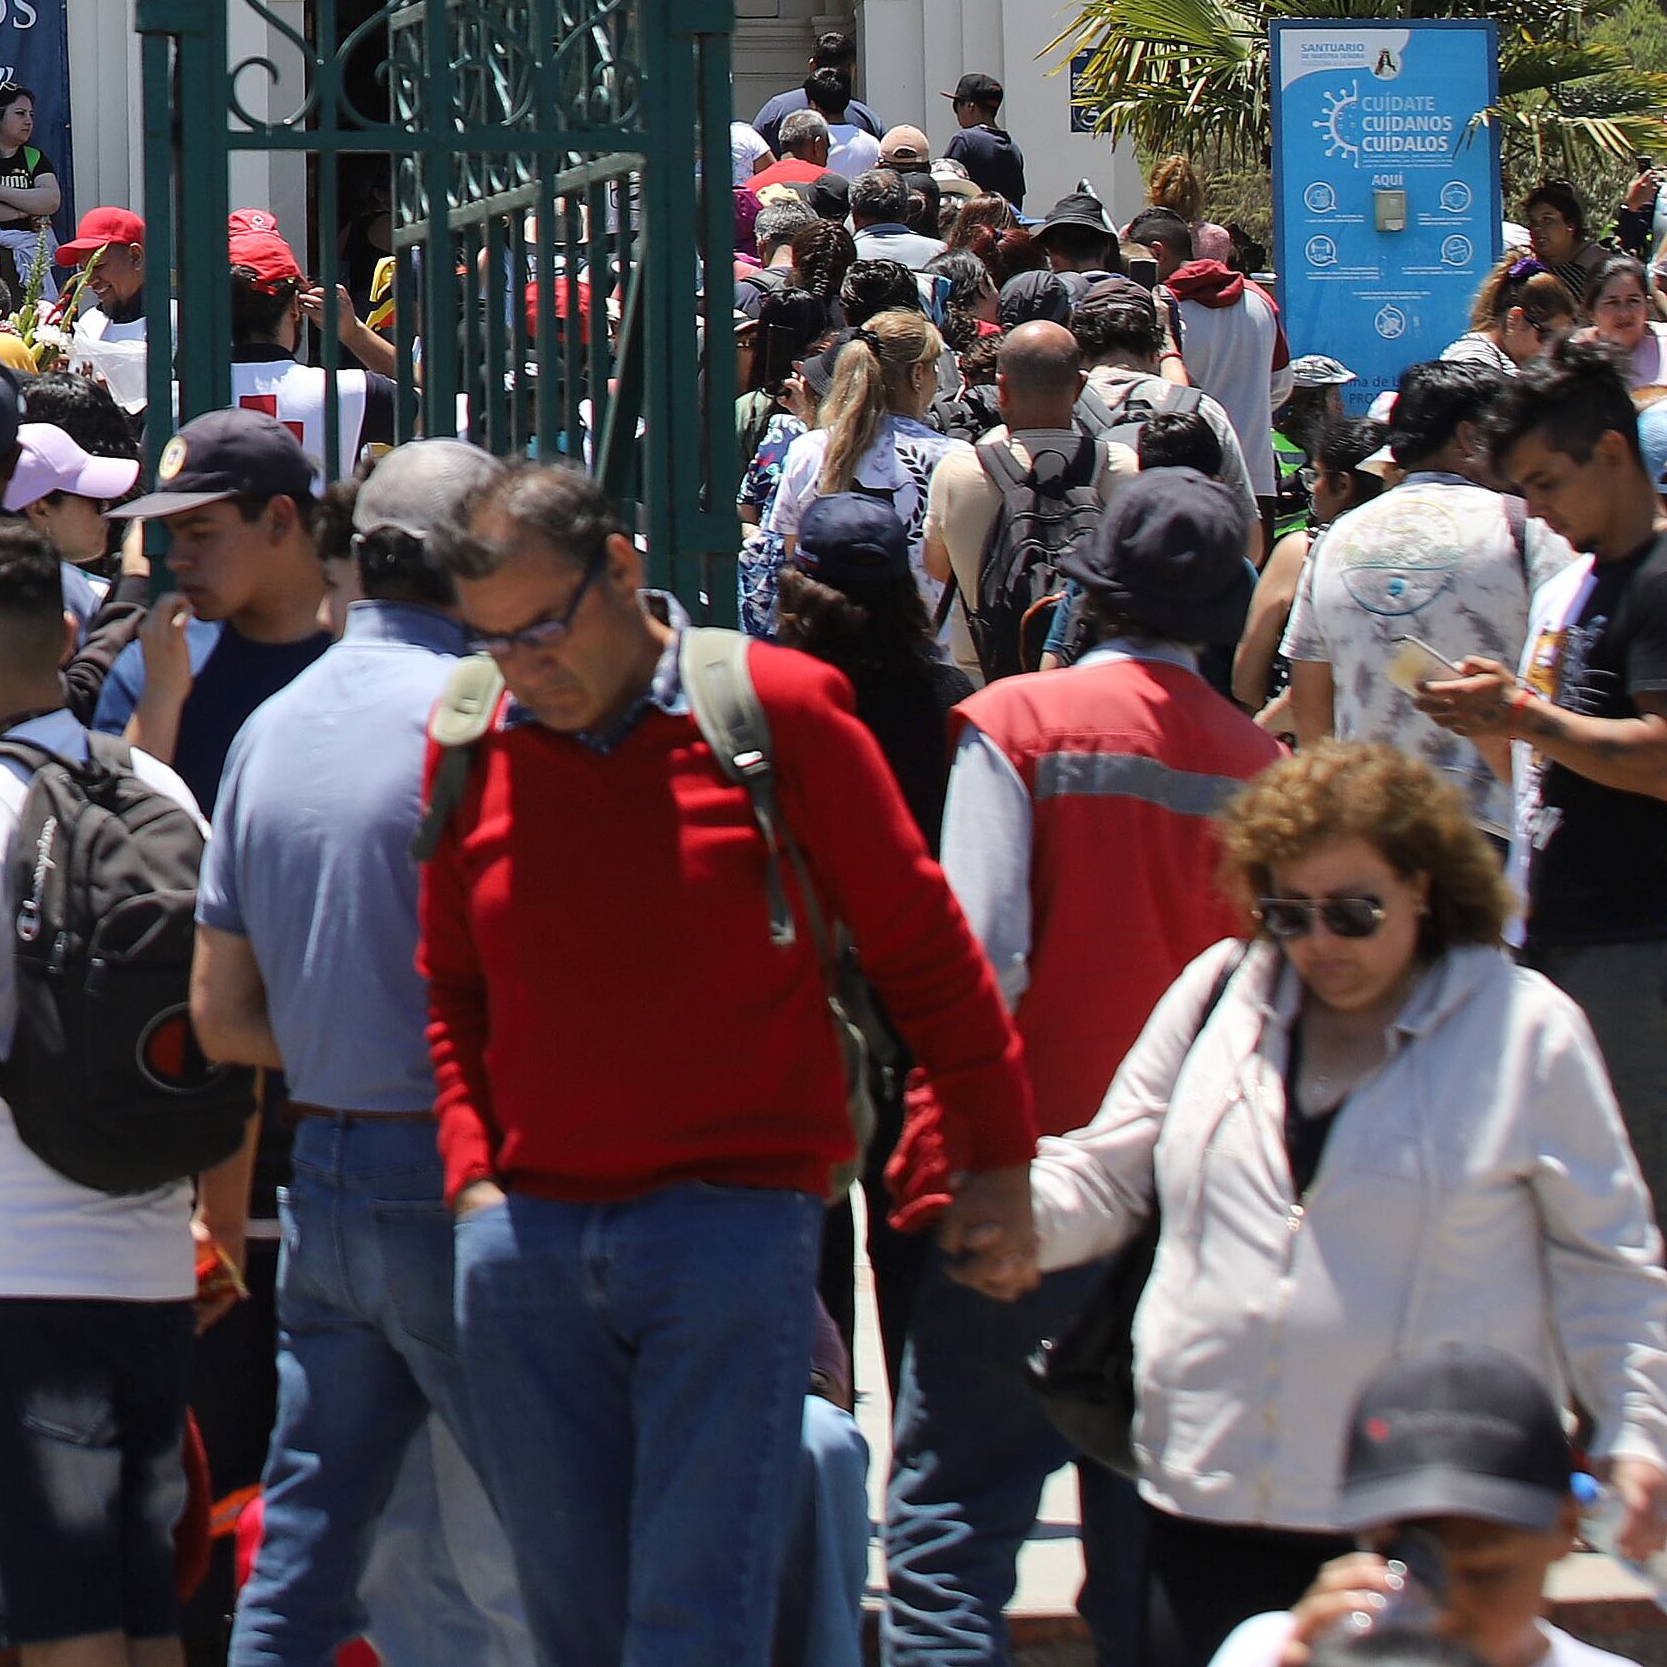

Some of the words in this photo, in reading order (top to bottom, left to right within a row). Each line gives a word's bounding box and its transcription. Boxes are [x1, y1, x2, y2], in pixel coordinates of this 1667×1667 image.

[1300, 43, 1365, 52] SANTUARIO
[1362, 92, 1435, 112] CUÍDATE
[1362, 111, 1452, 132] CUÍDANOS
[1362, 132, 1448, 152] CUÍDALOS
[1371, 171, 1404, 187] AQUÍ
